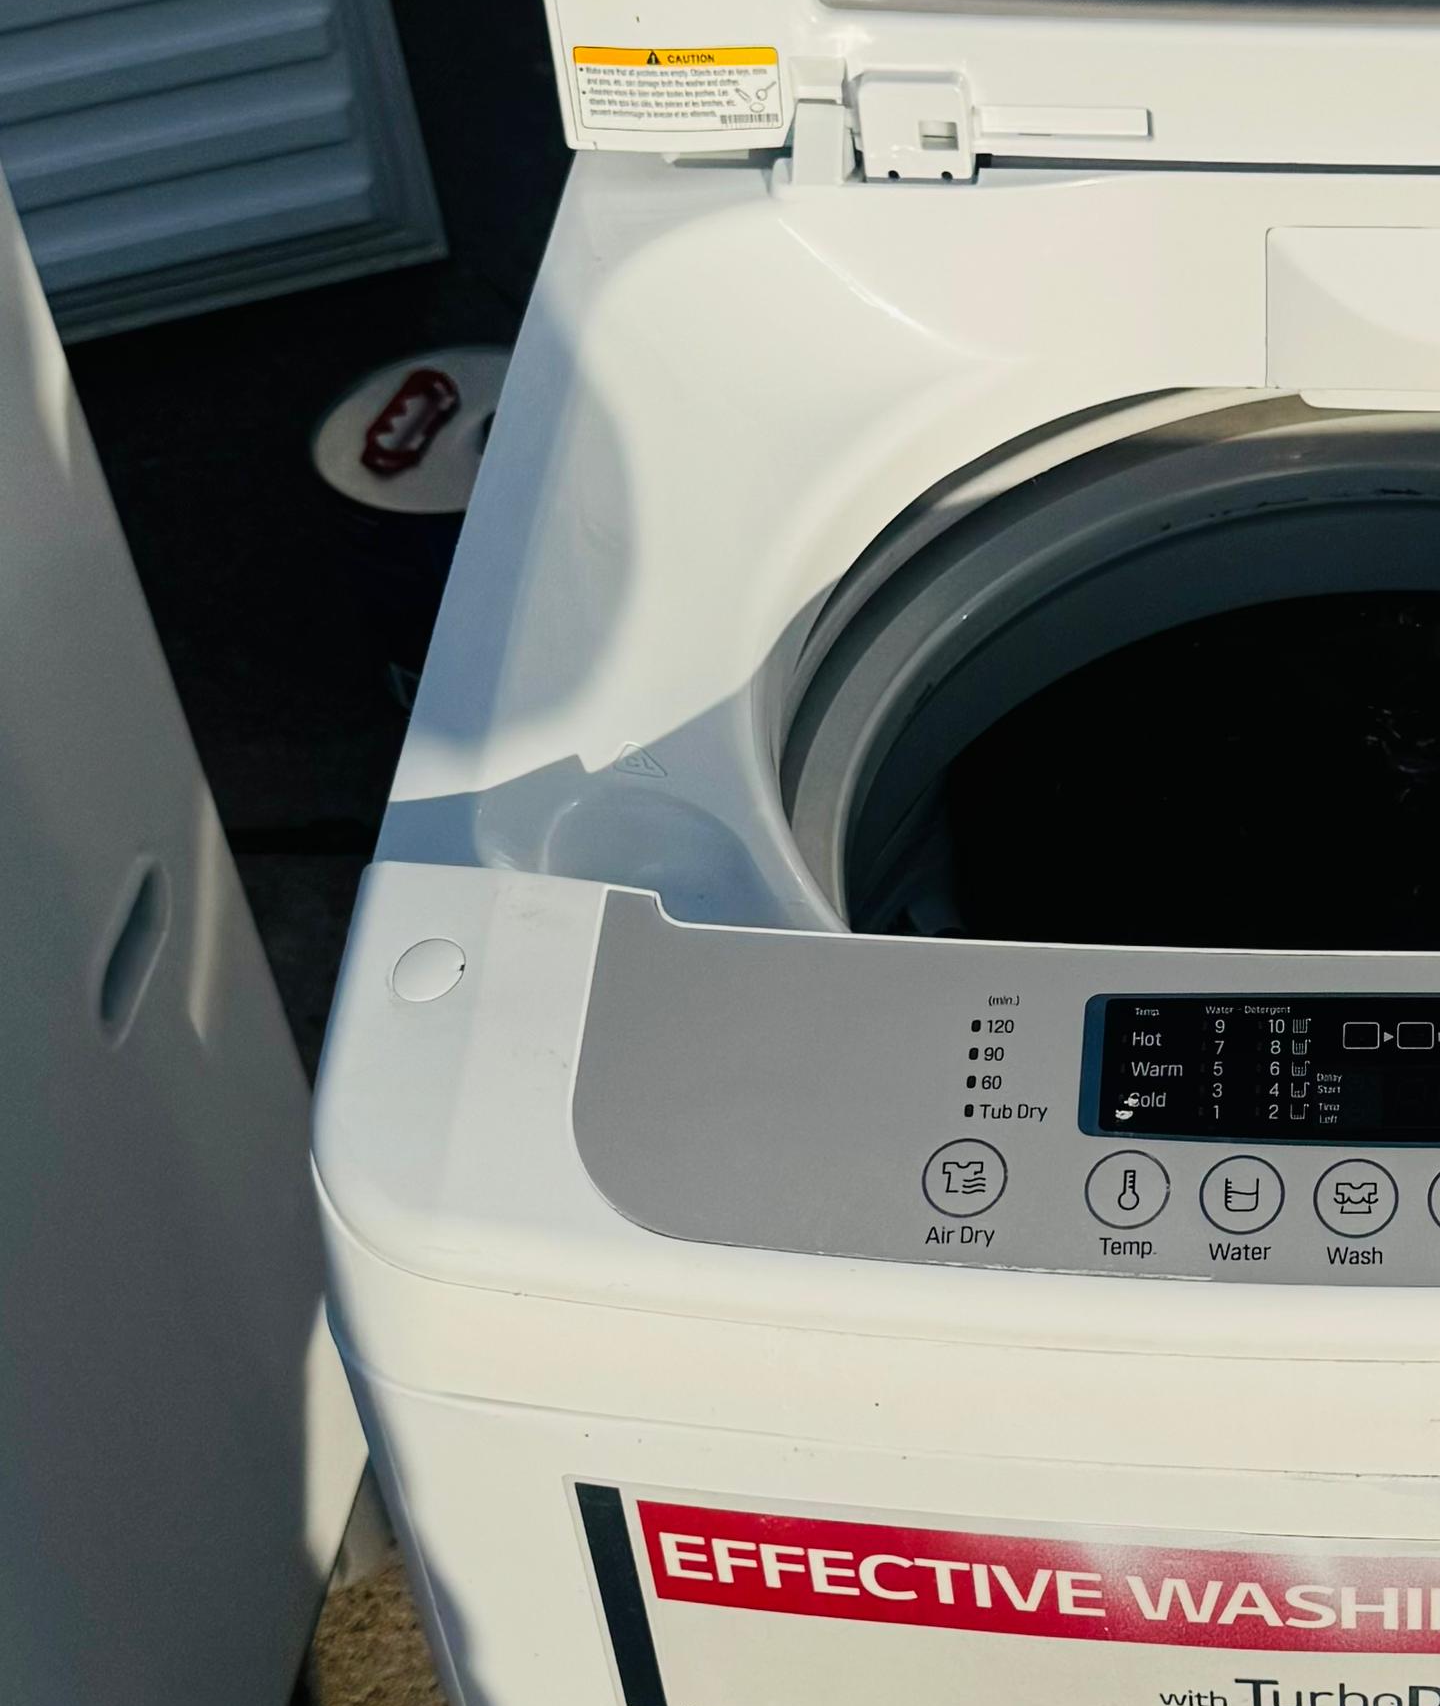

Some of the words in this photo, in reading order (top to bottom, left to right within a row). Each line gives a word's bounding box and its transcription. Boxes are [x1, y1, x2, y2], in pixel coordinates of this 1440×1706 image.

[667, 54, 715, 64] CAUTION
[988, 995, 1020, 1007] (min.)
[986, 1019, 1015, 1034] 120
[1214, 1019, 1226, 1034] 9
[1268, 1018, 1286, 1034] 10
[1132, 1031, 1163, 1047] Hot
[983, 1046, 1005, 1061] 90
[1214, 1040, 1225, 1055] 7
[1270, 1040, 1281, 1055] 8
[1131, 1061, 1183, 1077] Warm
[1213, 1061, 1223, 1076] 5
[1269, 1061, 1280, 1076] 6
[981, 1075, 1002, 1090] 60
[1212, 1082, 1223, 1098] 3
[1269, 1082, 1280, 1097] 4
[979, 1104, 1012, 1120] Tub
[1017, 1104, 1048, 1122] Dry
[1212, 1104, 1220, 1120] 1
[1268, 1104, 1279, 1120] 2
[924, 1226, 954, 1245] Air
[960, 1227, 996, 1248] Dry
[1100, 1238, 1157, 1259] Temp.
[1209, 1242, 1272, 1262] Water
[1326, 1246, 1384, 1266] Wash
[657, 1531, 1108, 1619] EFFECTIVE
